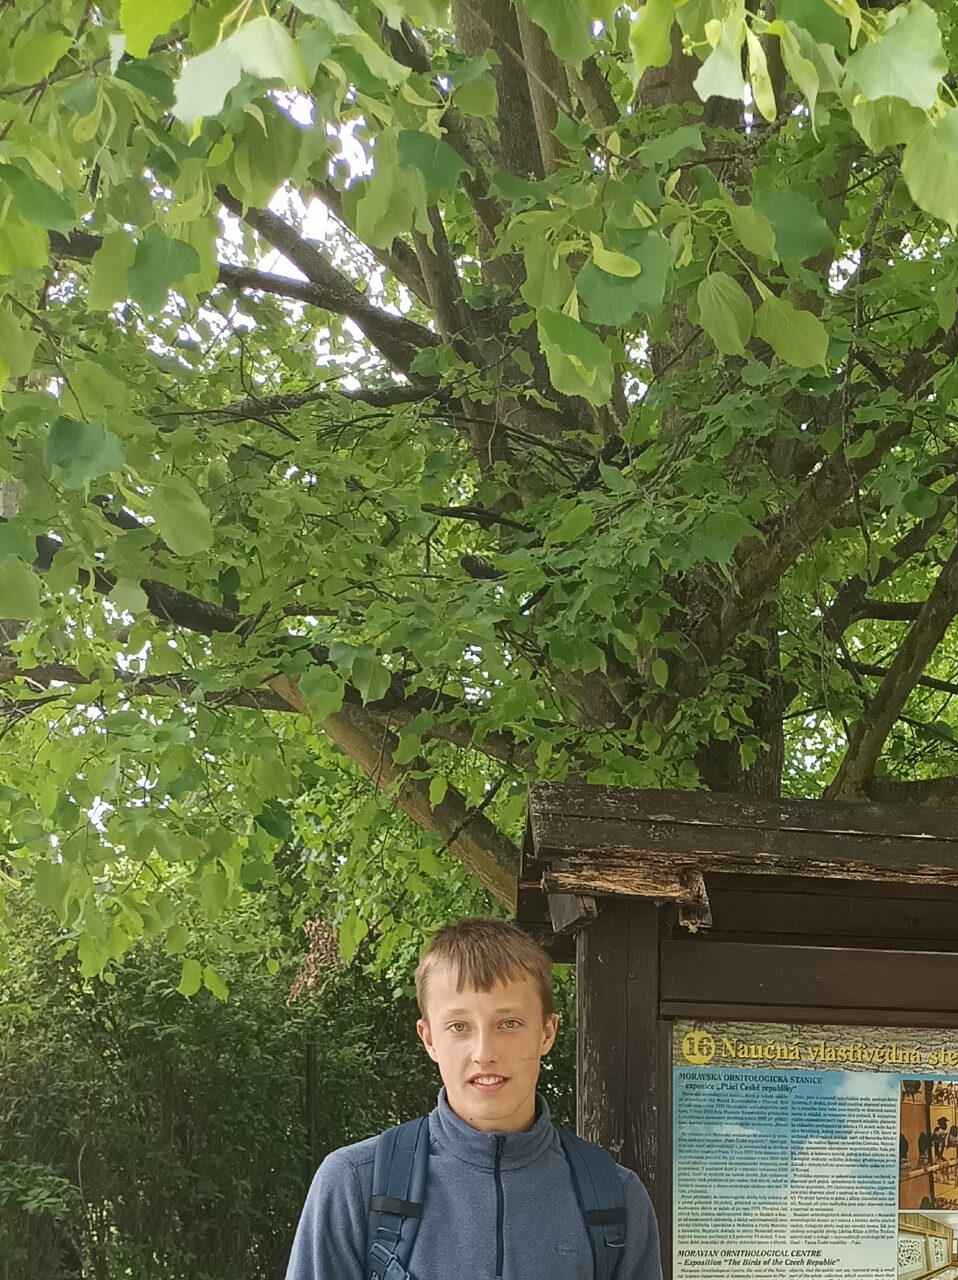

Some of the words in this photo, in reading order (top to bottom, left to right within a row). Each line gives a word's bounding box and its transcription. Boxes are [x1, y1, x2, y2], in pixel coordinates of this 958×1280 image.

[687, 1036, 711, 1057] 16
[720, 1038, 801, 1061] Naučná
[808, 1041, 922, 1065] vlastivědná
[679, 1072, 721, 1081] MORAVSKÁ
[723, 1074, 788, 1083] ORNITOLOGICKÁ
[790, 1076, 822, 1084] STANICE
[685, 1082, 714, 1090] expozice
[741, 1082, 760, 1091] České
[720, 1249, 789, 1257] ORNITHOLOGICAL
[790, 1249, 822, 1257] CENTRE
[684, 1259, 721, 1267] Exposition
[742, 1258, 761, 1266] Birds
[762, 1258, 772, 1266] of
[772, 1258, 783, 1266] the
[785, 1258, 804, 1266] Czech
